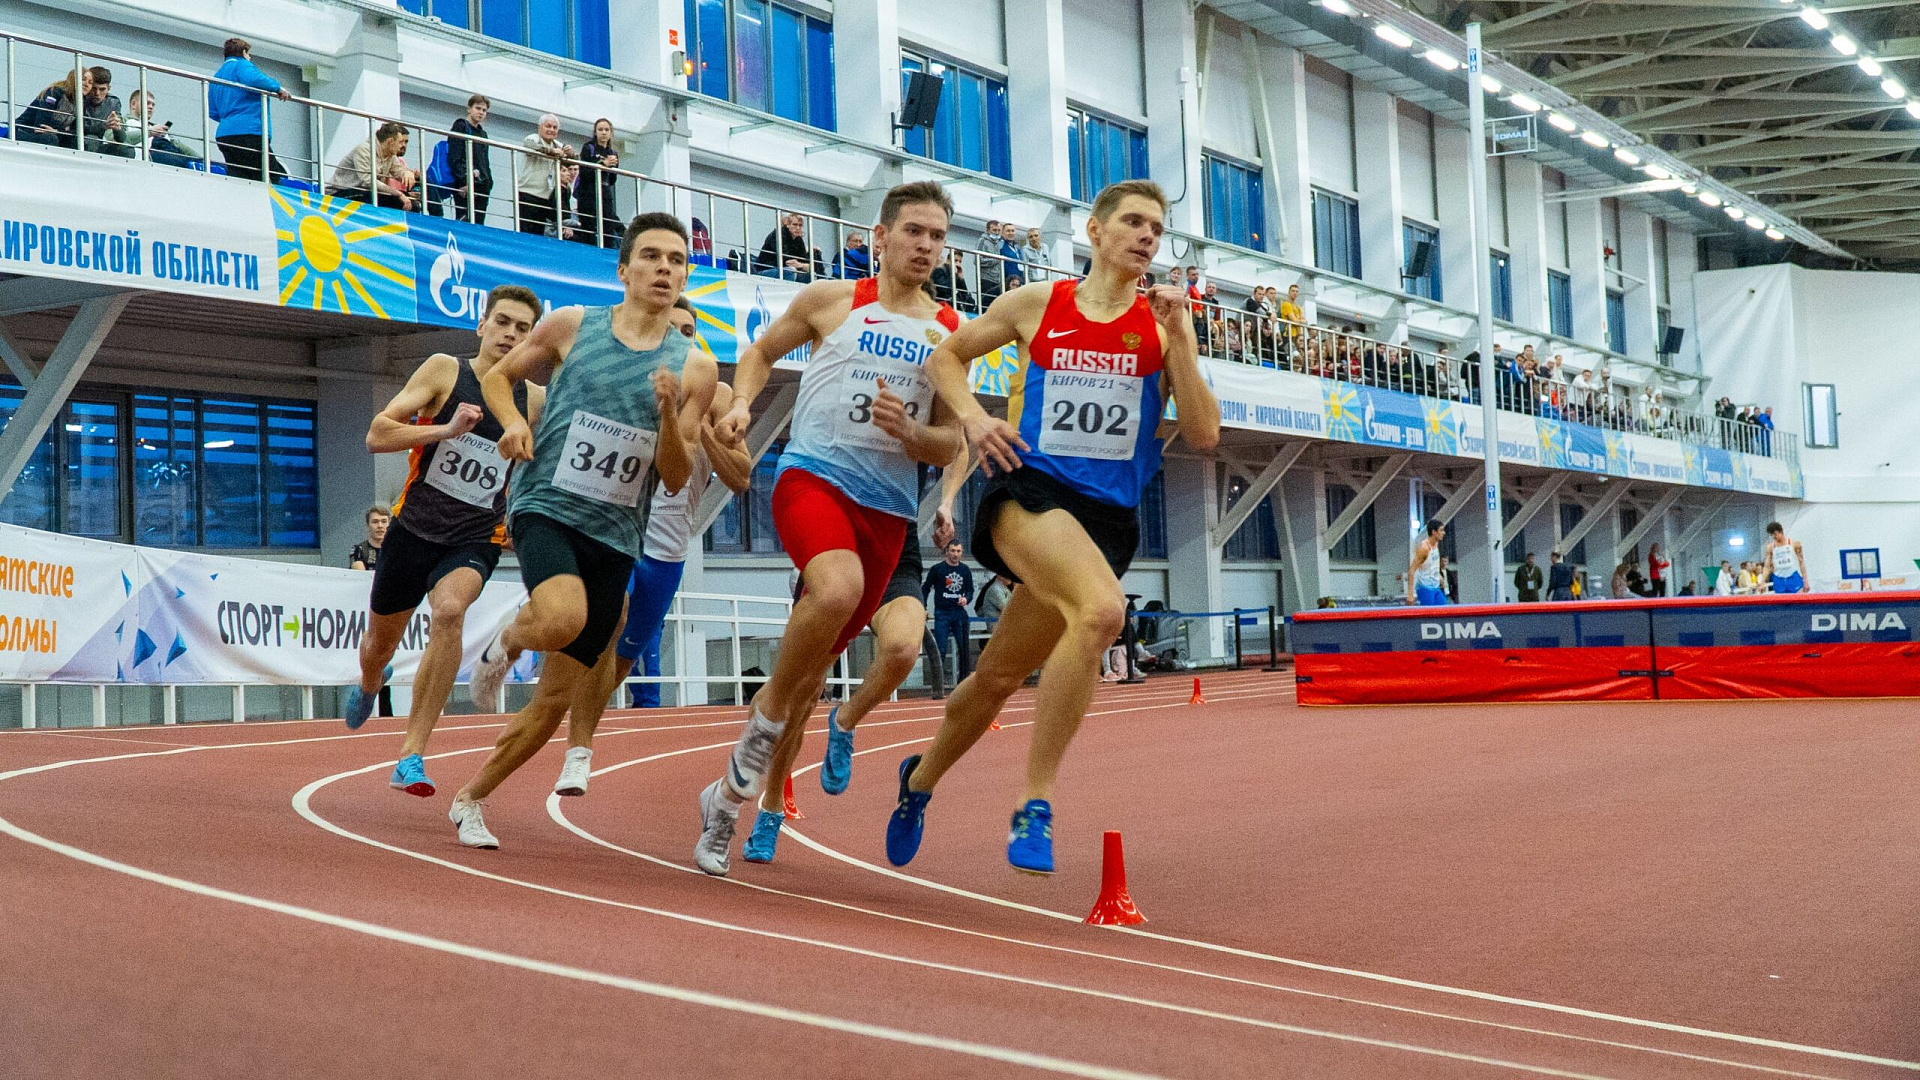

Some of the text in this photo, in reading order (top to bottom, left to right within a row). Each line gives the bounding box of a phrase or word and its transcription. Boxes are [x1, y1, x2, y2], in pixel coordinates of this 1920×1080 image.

[0, 219, 259, 291] ИРОВСКОЙ ОБЛАСТИ
[1052, 347, 1138, 375] RUSSIA
[1051, 400, 1129, 436] 202
[440, 450, 499, 490] 308
[570, 441, 641, 484] 349
[217, 600, 284, 647] СПОРТ
[1421, 621, 1502, 640] DIMA
[1810, 612, 1906, 632] DIMA
